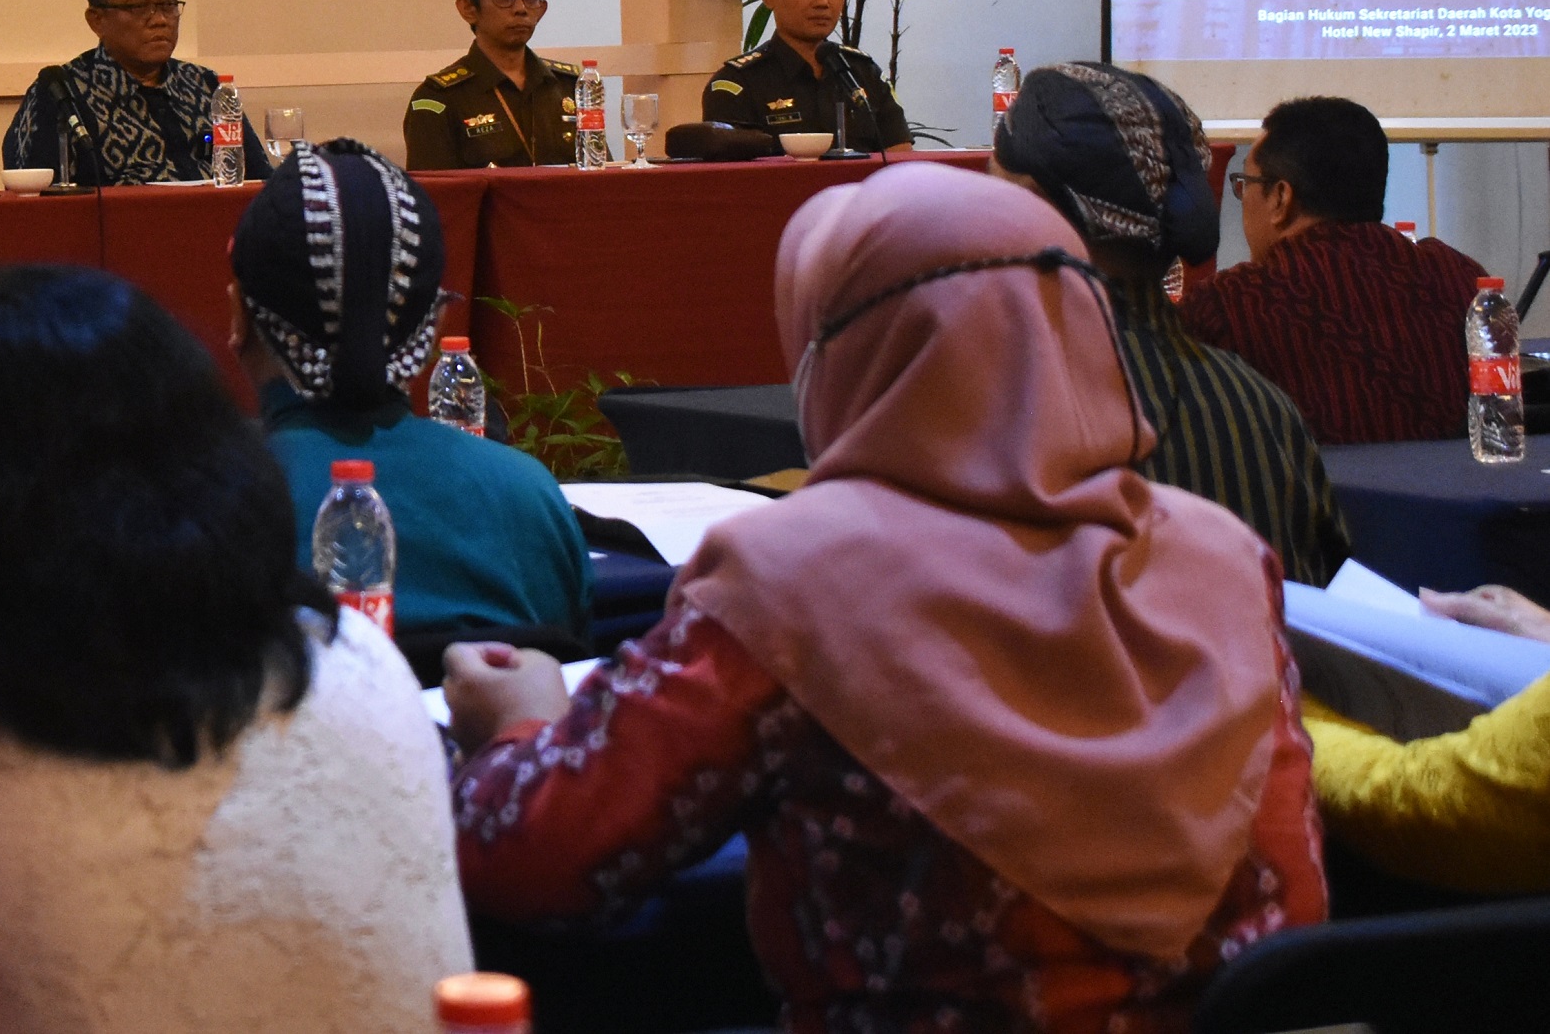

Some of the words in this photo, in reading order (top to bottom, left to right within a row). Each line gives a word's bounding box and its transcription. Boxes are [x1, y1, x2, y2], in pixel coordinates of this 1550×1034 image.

[1258, 9, 1304, 23] Bagian
[1308, 9, 1355, 21] Hukum
[1359, 8, 1434, 21] Sekretariat
[1438, 7, 1486, 19] Daerah
[1490, 7, 1522, 19] Kota
[1322, 26, 1359, 38] Hotel
[1362, 26, 1392, 38] New
[1395, 25, 1443, 39] Shapir,
[1446, 25, 1456, 37] 2
[1459, 24, 1500, 37] Maret
[1503, 24, 1538, 36] 2023
